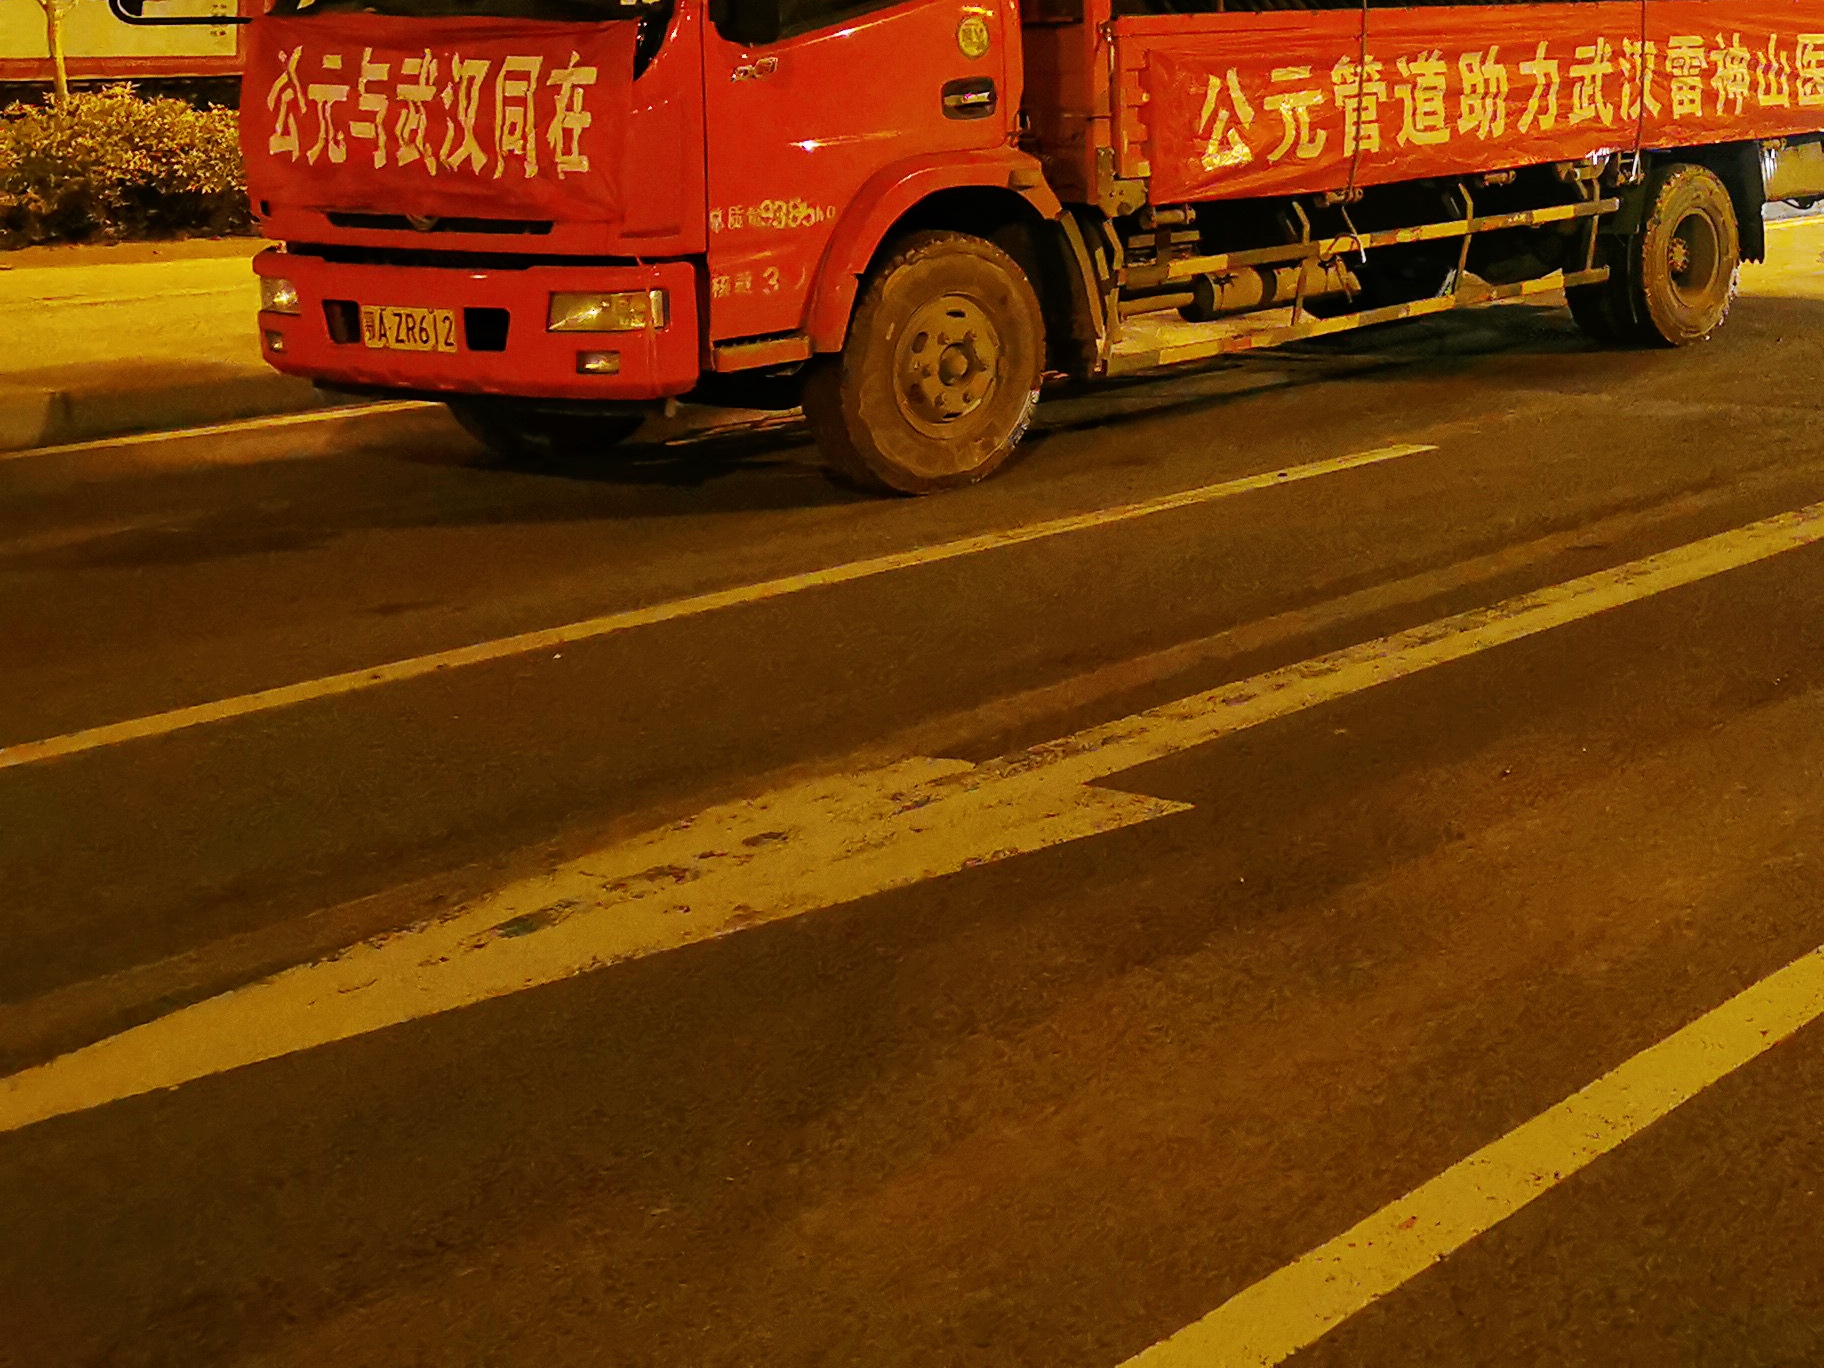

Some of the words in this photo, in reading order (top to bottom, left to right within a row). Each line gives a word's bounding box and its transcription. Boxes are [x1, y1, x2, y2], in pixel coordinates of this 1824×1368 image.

[267, 45, 598, 180] 公元与武汉同在
